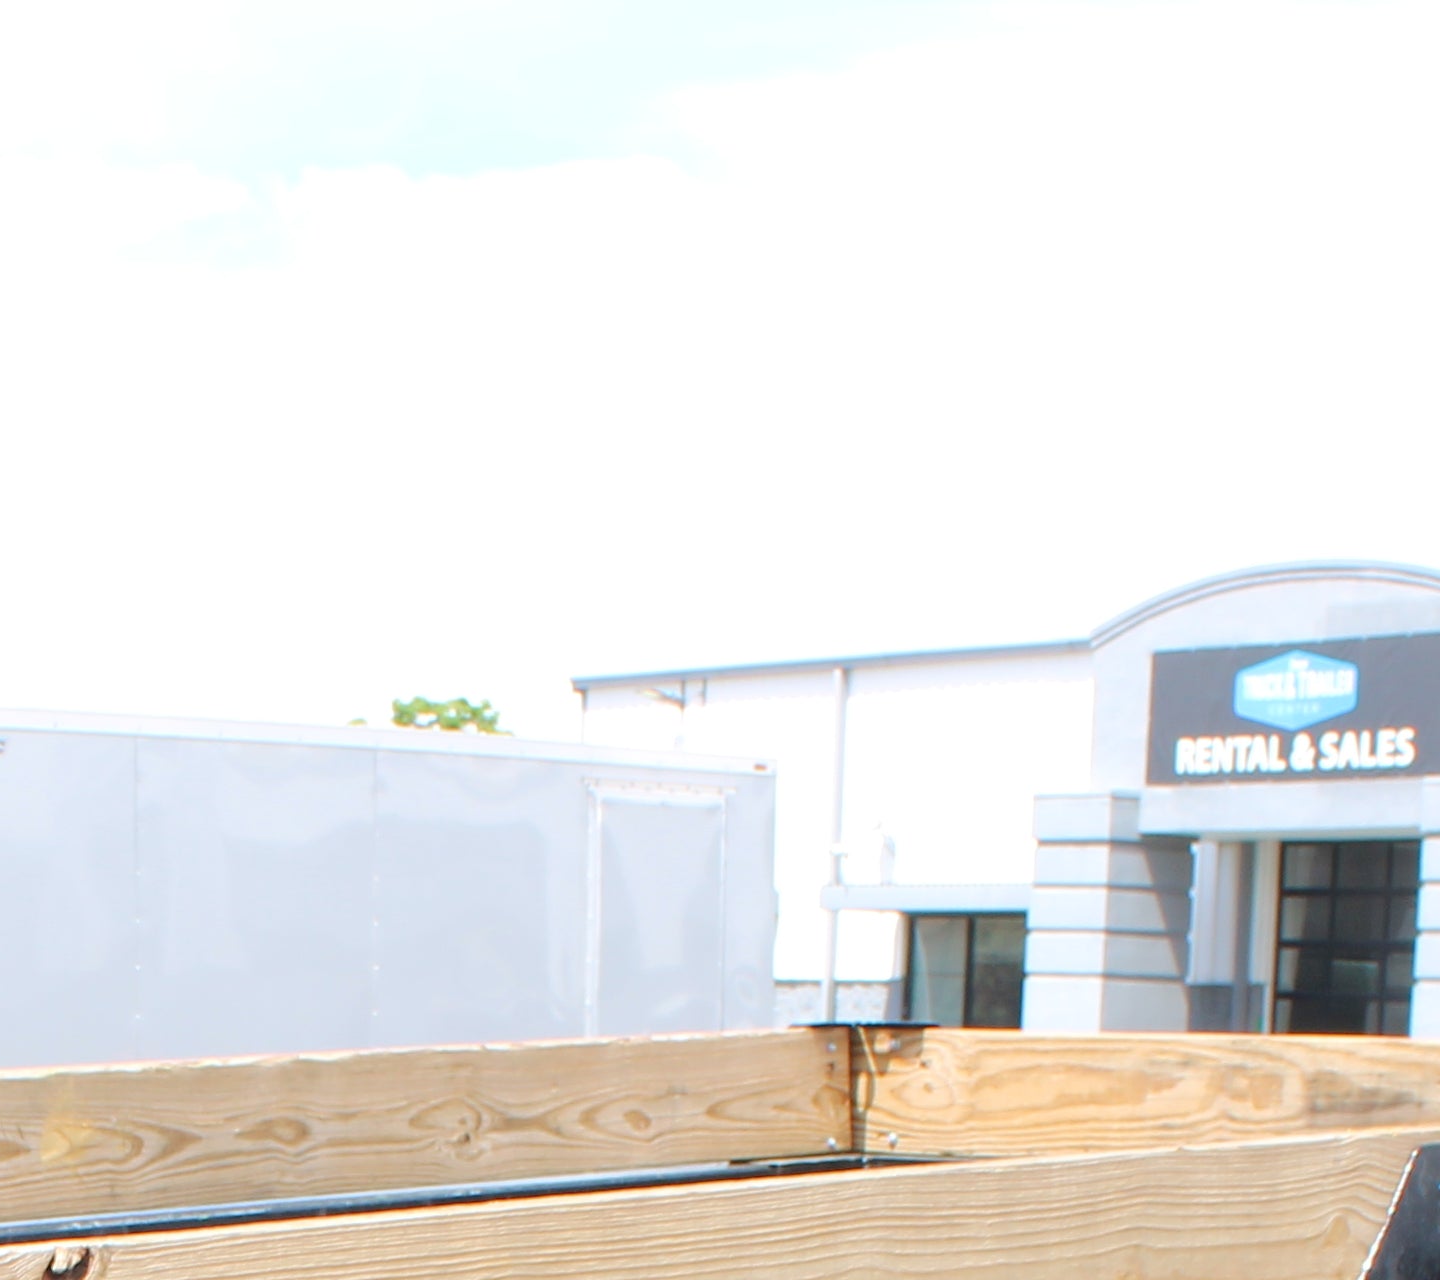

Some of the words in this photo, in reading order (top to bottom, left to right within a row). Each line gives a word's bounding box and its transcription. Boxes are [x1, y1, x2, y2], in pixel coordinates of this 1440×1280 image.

[1175, 733, 1287, 776] RENTAL
[1289, 732, 1316, 772] &
[1319, 727, 1416, 770] SALES
